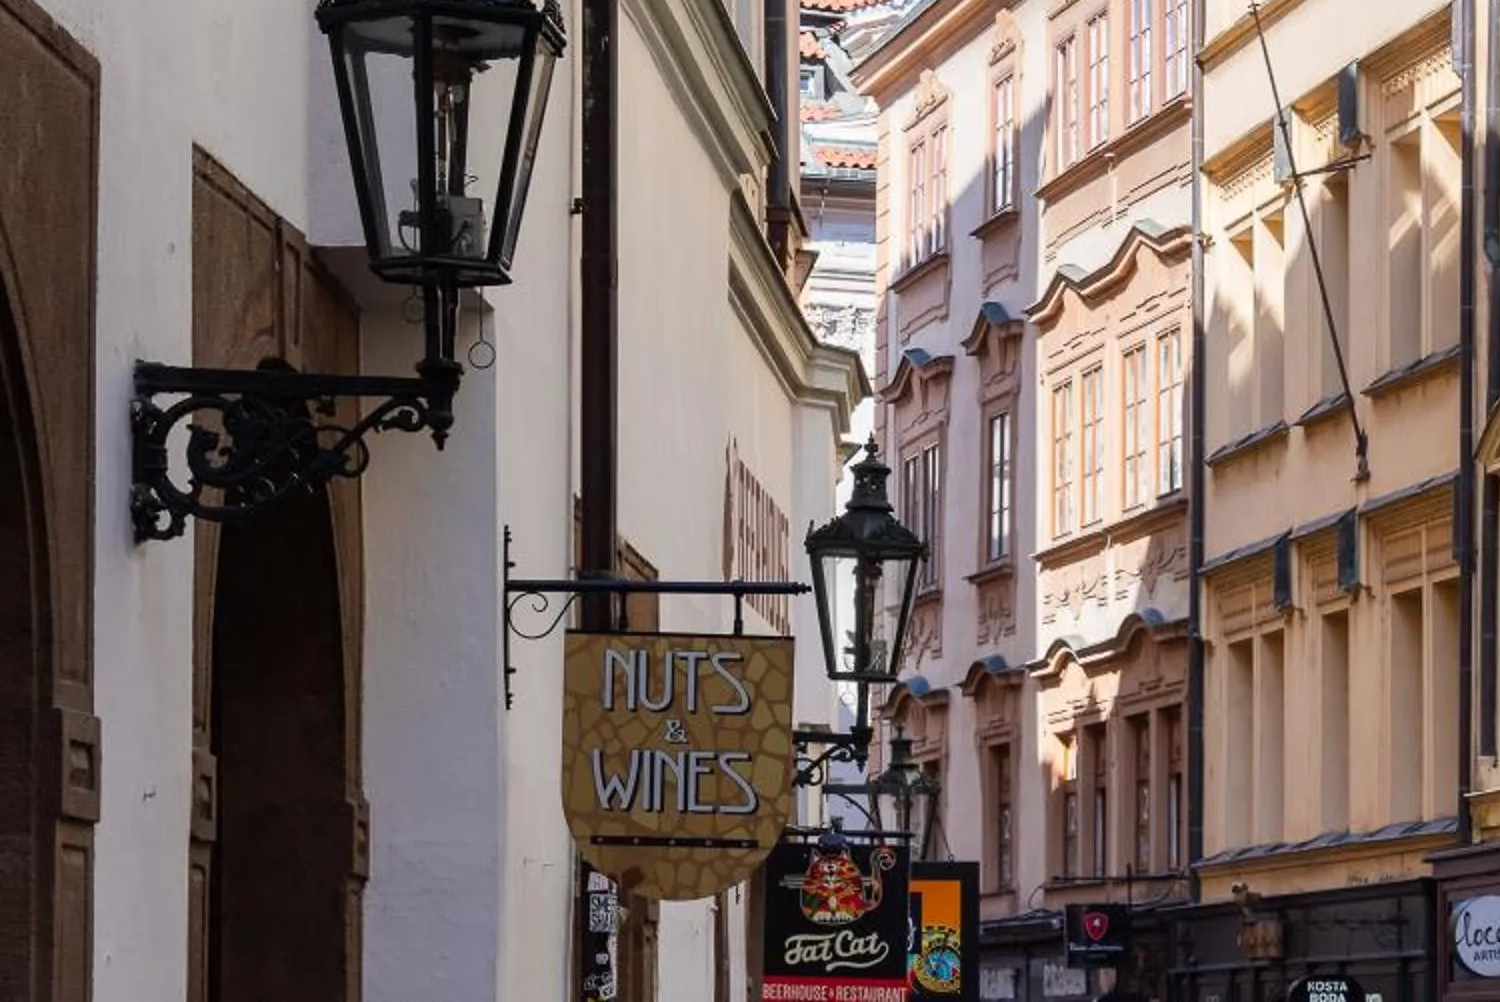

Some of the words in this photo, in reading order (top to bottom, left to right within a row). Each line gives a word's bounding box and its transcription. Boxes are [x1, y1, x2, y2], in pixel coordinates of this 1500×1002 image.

[603, 649, 751, 715] NUTS
[664, 719, 688, 743] &
[592, 749, 758, 815] WINES
[784, 933, 836, 966] Fat
[828, 929, 889, 968] Cat
[763, 983, 828, 1001] BEERHOUSE
[836, 985, 908, 1002] RESTAURANT
[1307, 981, 1349, 992] KOSTA
